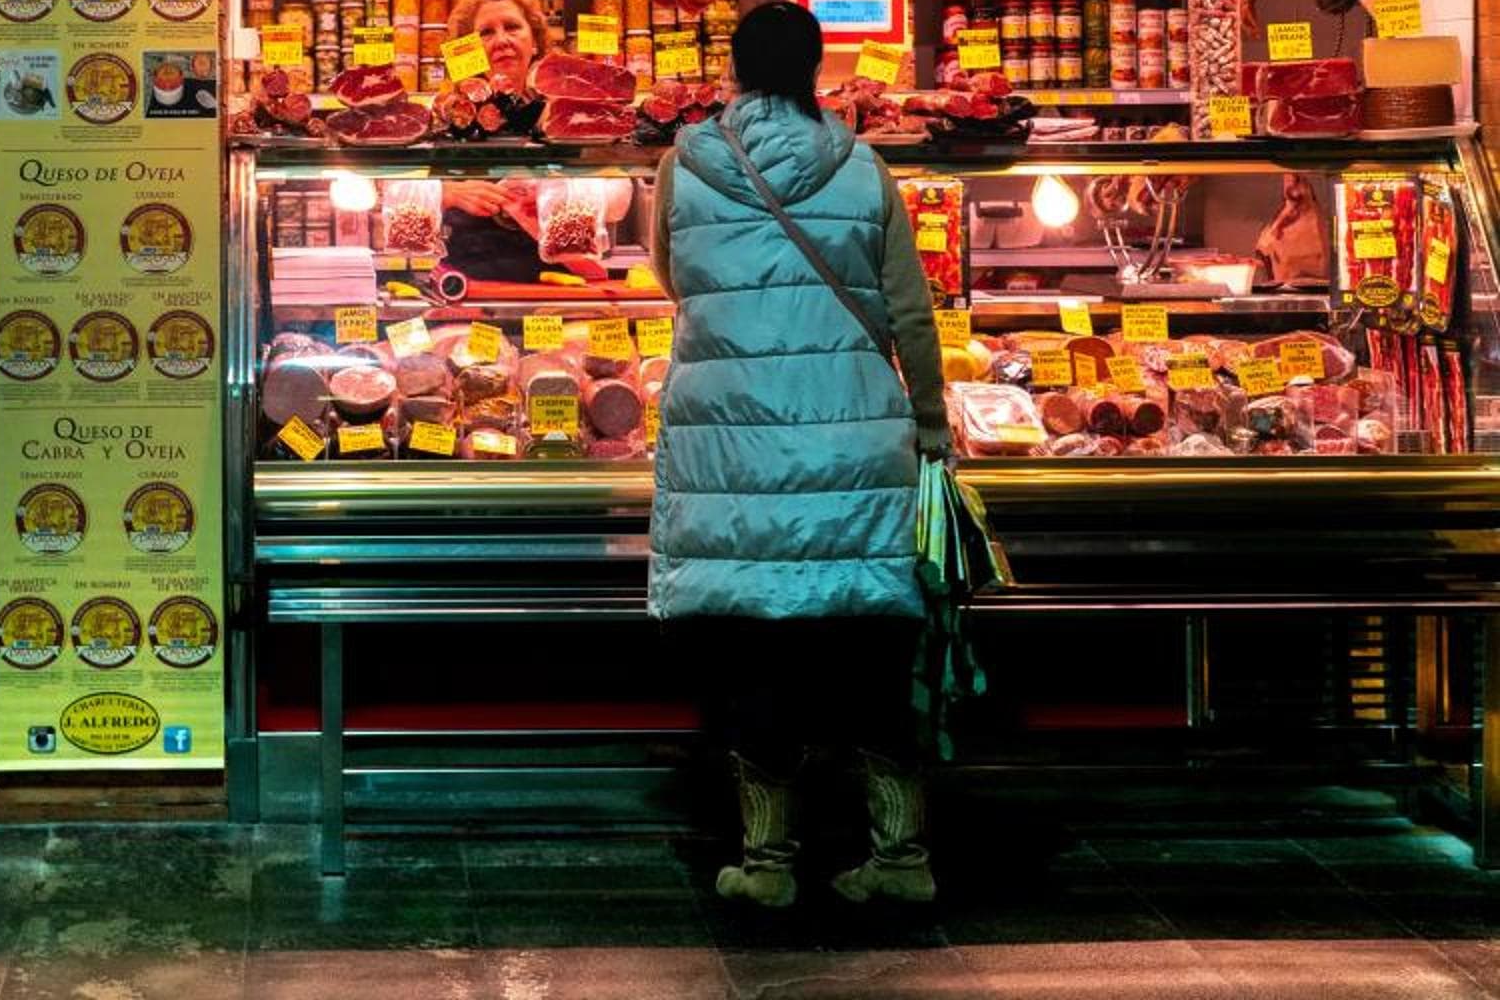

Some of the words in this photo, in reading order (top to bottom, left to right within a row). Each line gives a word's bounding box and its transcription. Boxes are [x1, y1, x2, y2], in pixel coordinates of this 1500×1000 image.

[19, 159, 88, 187] QUESO
[95, 168, 118, 181] DE
[125, 161, 184, 184] OVEJA
[53, 417, 122, 445] QUESO
[130, 426, 153, 439] DE
[21, 440, 85, 460] CABRA
[102, 446, 112, 459] Y
[125, 440, 186, 460] OVEJA
[73, 697, 146, 713] CHARCUTERIA
[64, 717, 77, 729] J.
[81, 716, 157, 728] ALFREDO
